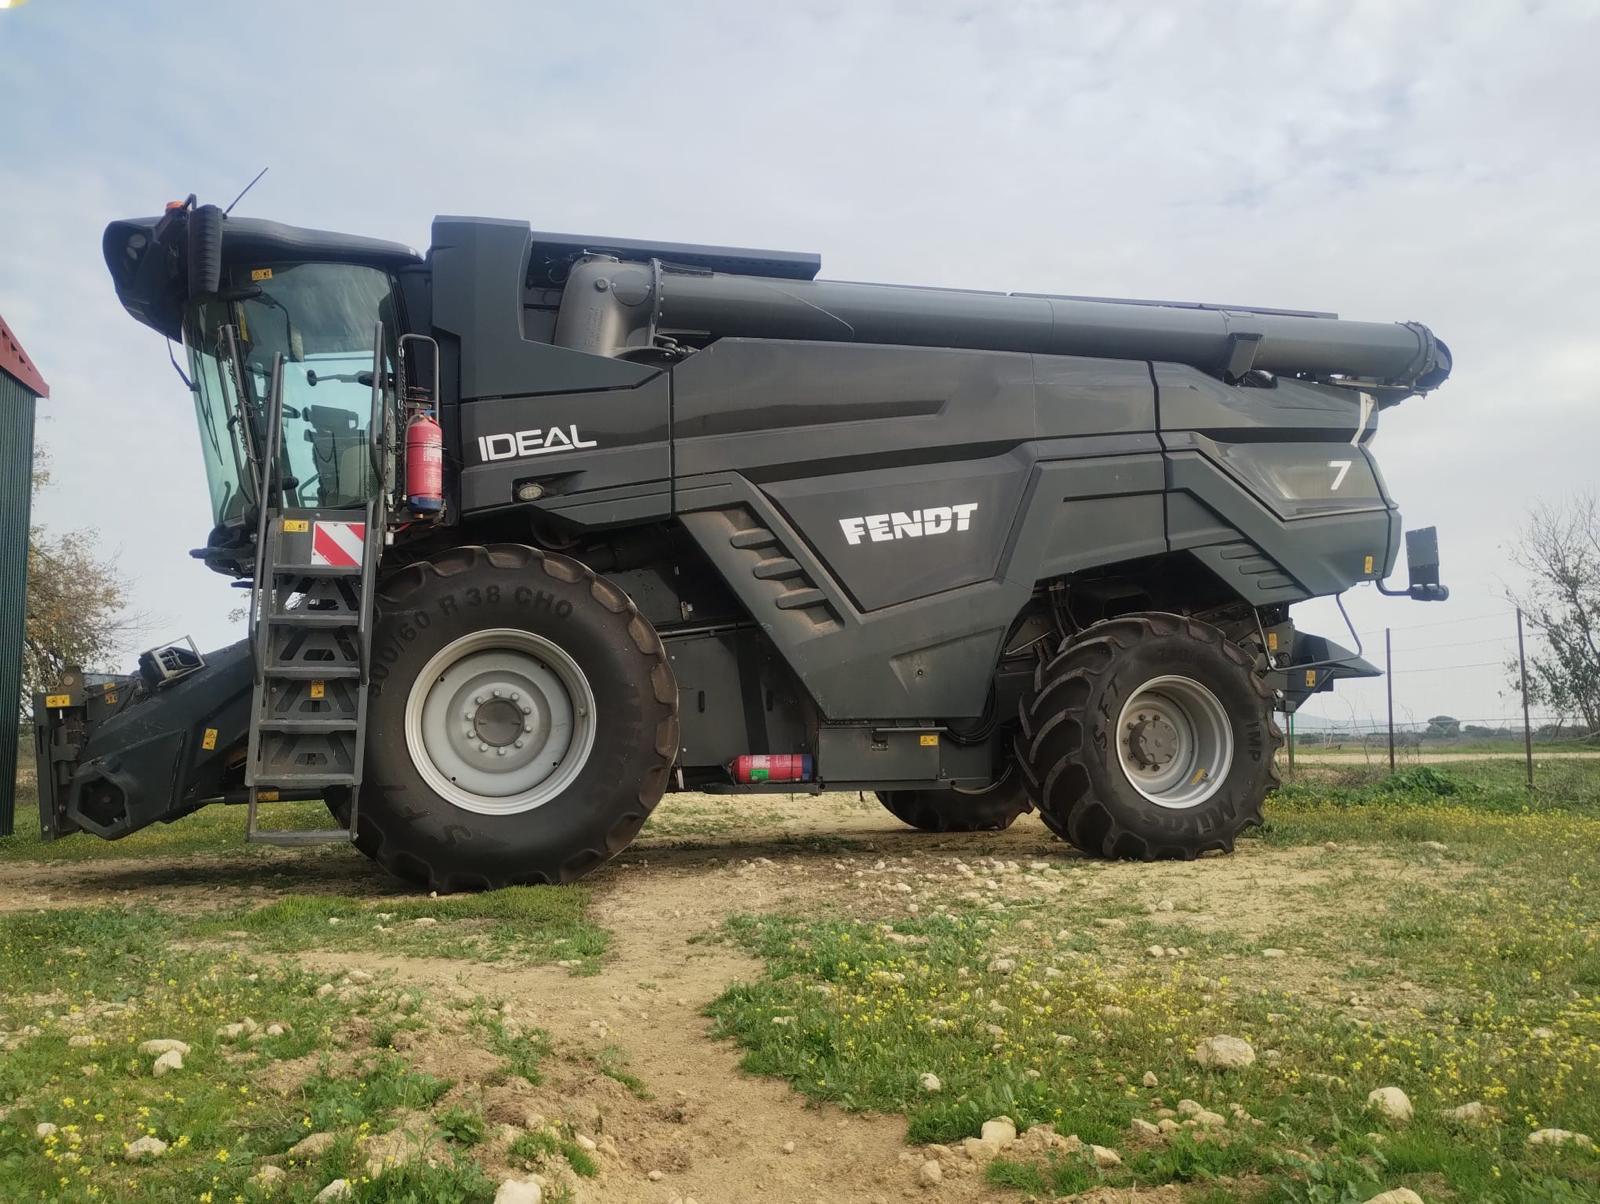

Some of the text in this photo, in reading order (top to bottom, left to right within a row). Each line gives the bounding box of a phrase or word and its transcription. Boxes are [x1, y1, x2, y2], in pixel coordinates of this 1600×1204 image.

[478, 424, 598, 462] IDEAL
[1328, 460, 1352, 490] 7
[838, 502, 979, 545] FENDT
